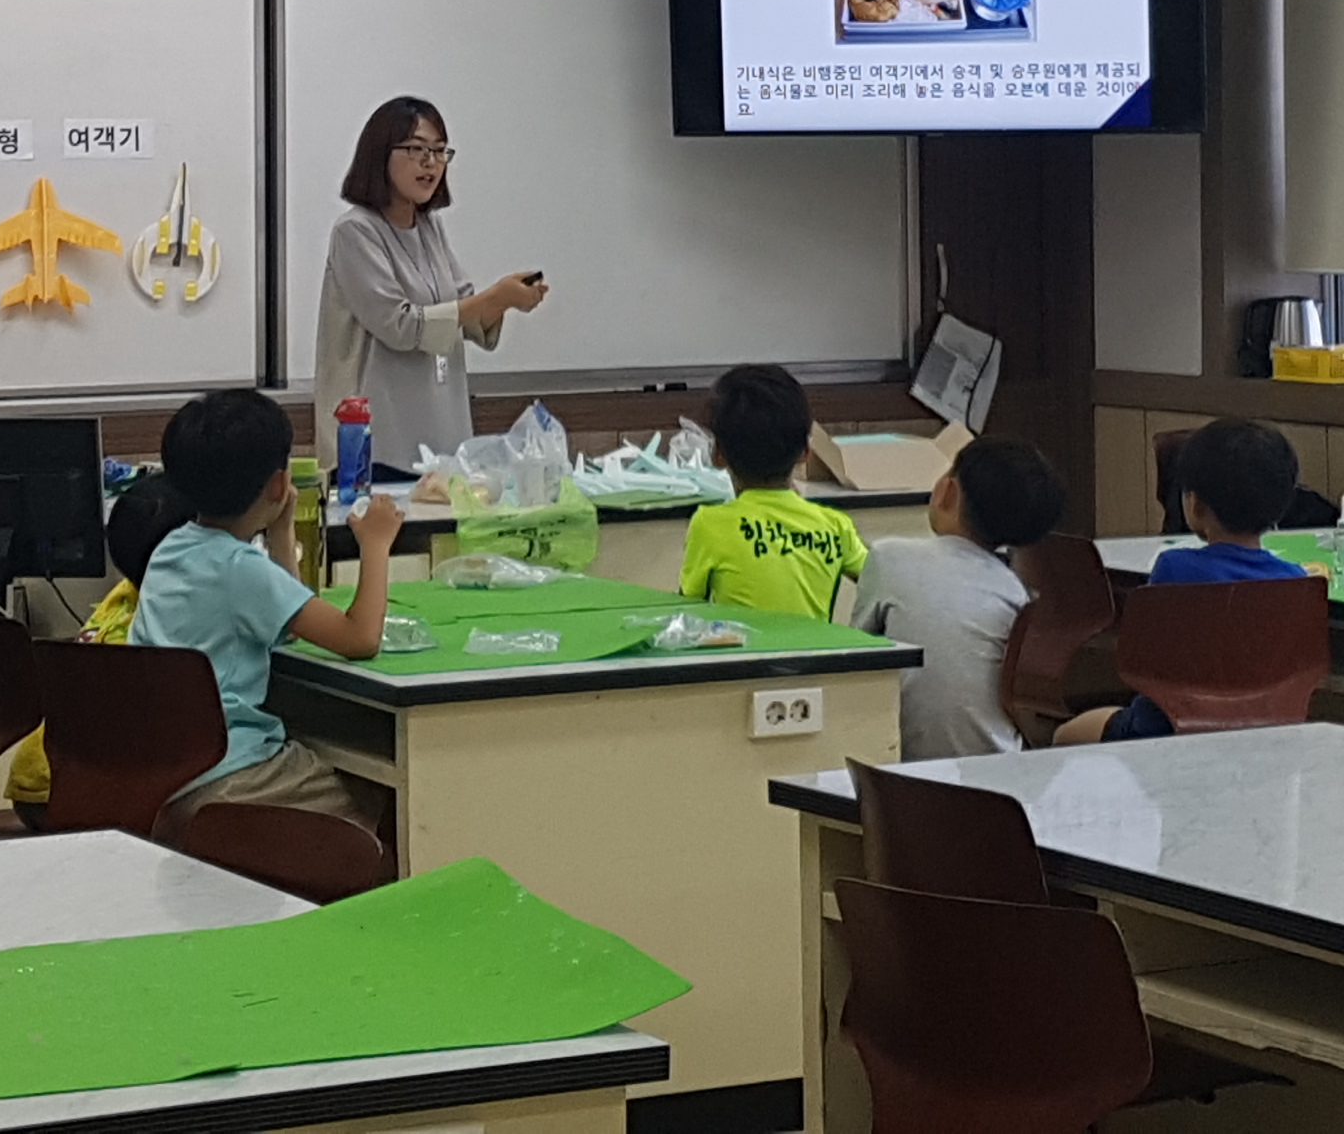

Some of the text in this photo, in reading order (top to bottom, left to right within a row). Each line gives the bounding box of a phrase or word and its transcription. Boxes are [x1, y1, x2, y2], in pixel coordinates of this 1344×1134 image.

[736, 65, 796, 81] 기내식은
[802, 65, 862, 81] 비행중인
[825, 83, 855, 99] 미리
[862, 83, 907, 99] 조리해
[67, 124, 140, 153] 여객기
